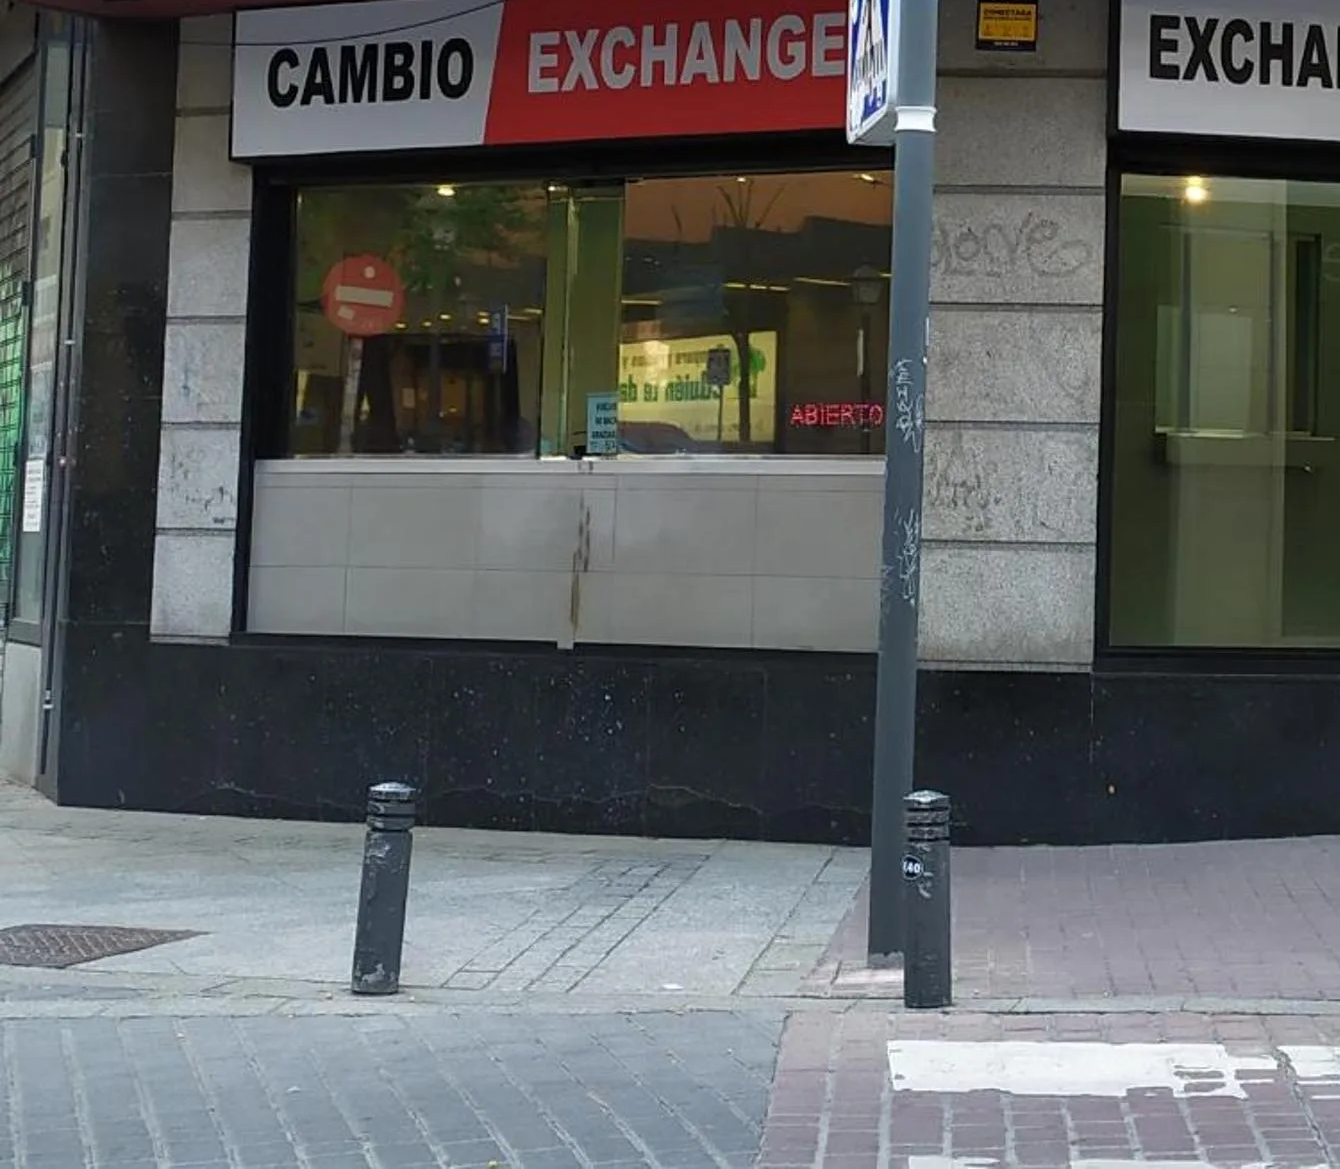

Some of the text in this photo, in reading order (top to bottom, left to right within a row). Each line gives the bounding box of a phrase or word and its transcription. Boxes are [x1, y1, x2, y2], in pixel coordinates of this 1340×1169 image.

[266, 36, 474, 109] CAMBIO
[527, 12, 847, 94] EXCHANGE
[790, 403, 884, 428] ABIERTO
